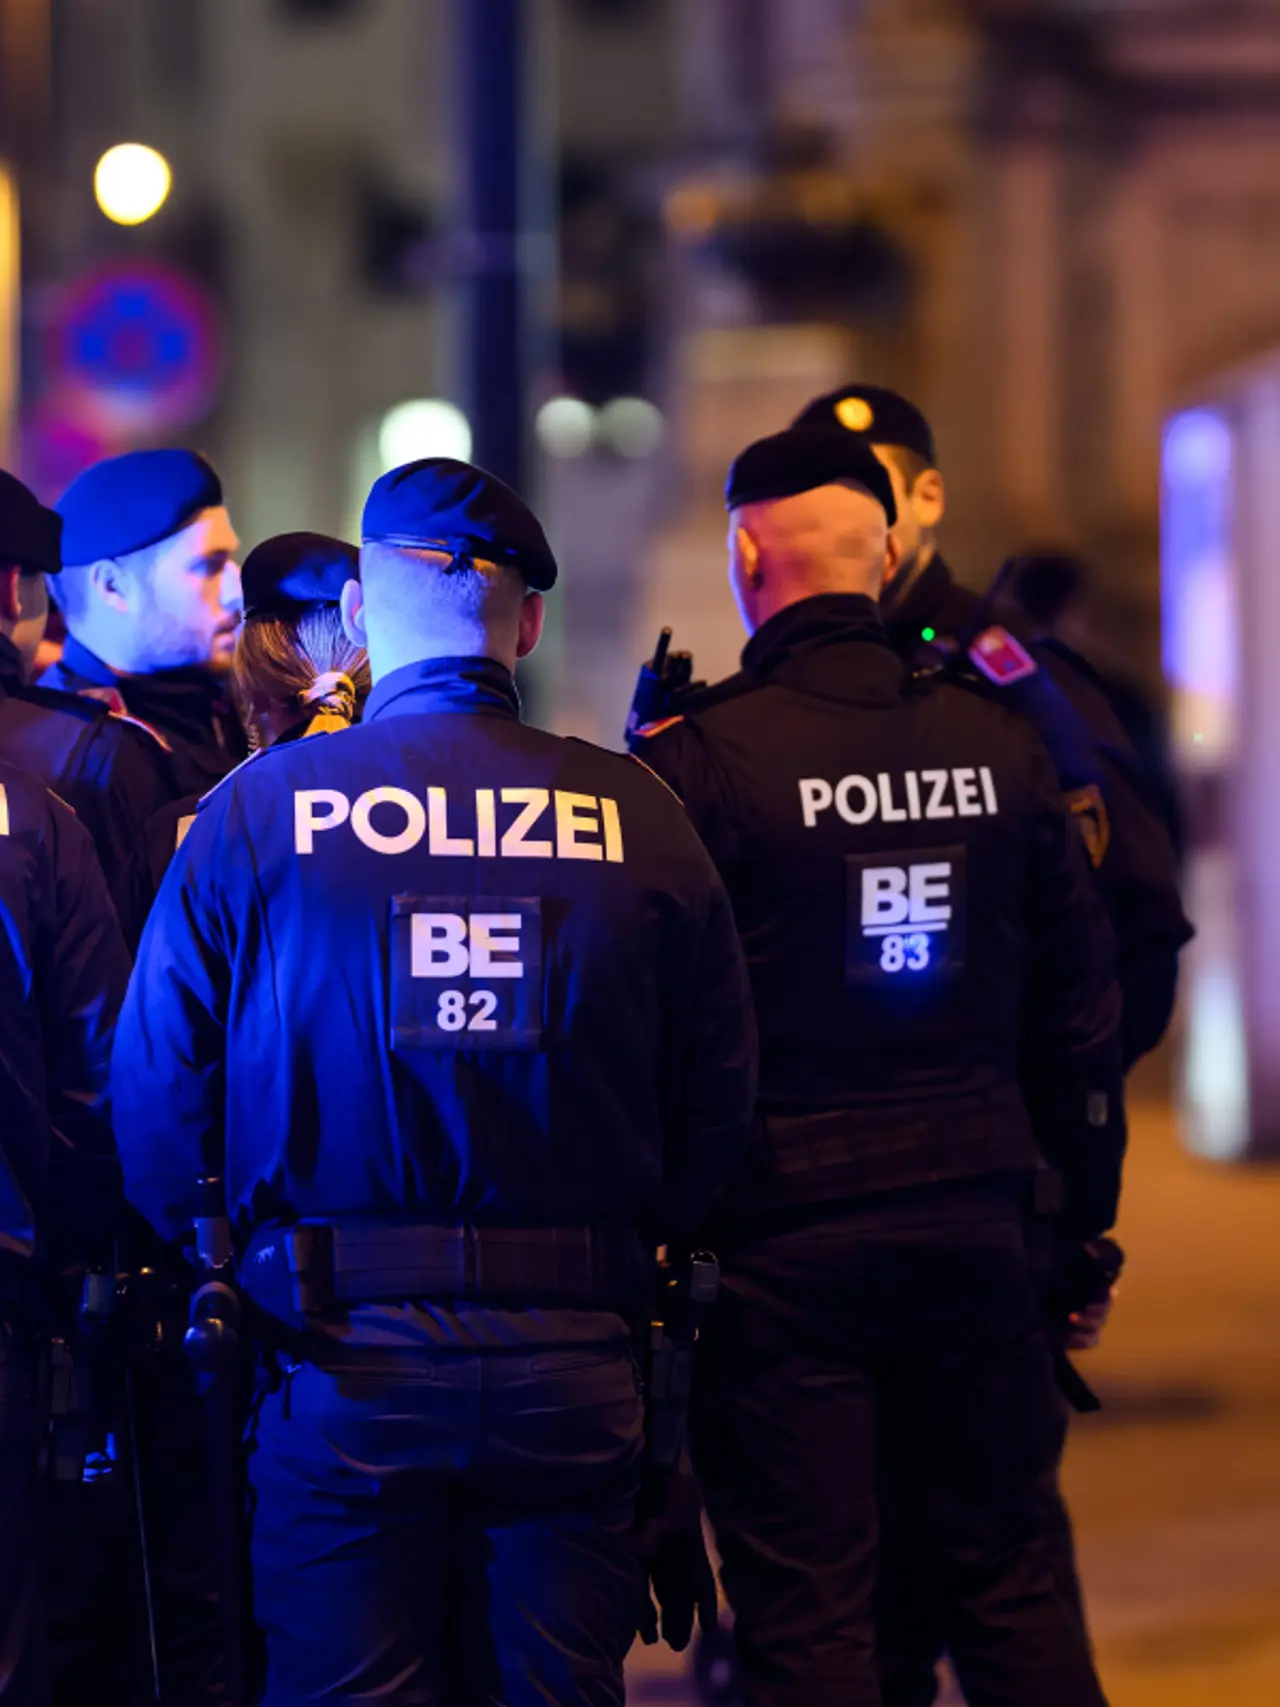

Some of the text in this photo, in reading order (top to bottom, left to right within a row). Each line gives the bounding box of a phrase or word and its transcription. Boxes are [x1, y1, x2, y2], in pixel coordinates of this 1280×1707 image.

[294, 786, 624, 863] POLIZEI
[798, 766, 998, 828] POLIZEI
[861, 862, 952, 926] BE
[411, 913, 524, 978] BE
[879, 932, 931, 973] 83
[436, 989, 498, 1032] 82
